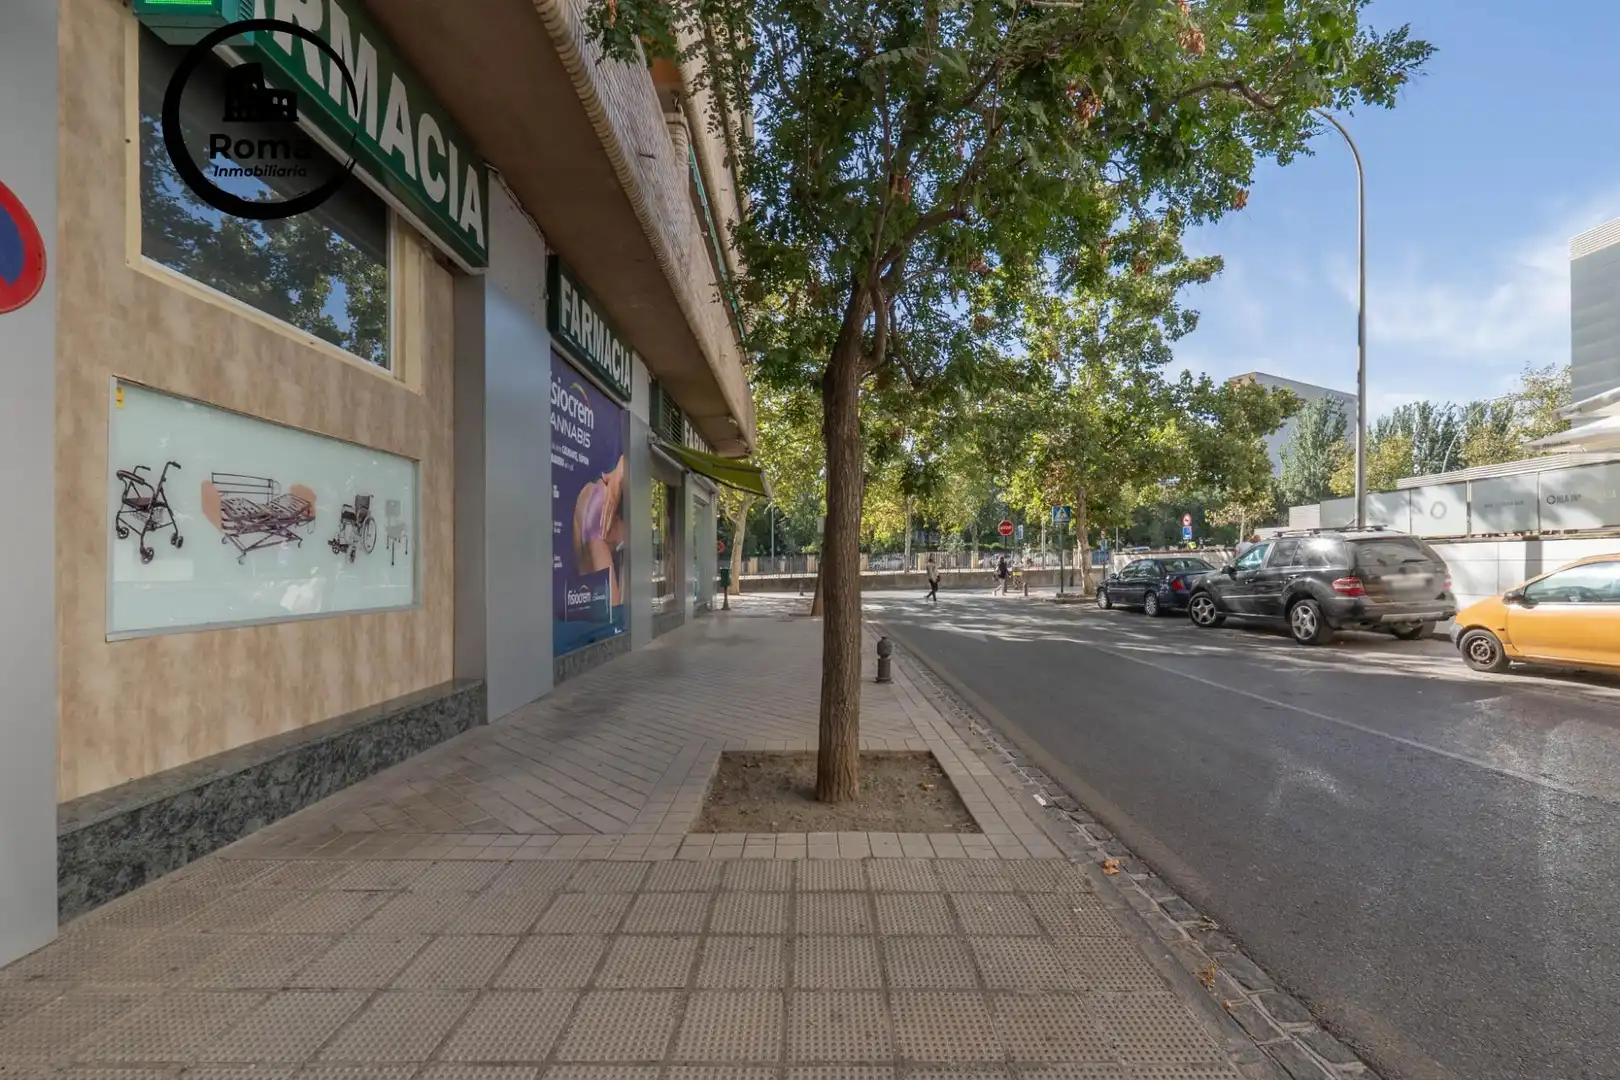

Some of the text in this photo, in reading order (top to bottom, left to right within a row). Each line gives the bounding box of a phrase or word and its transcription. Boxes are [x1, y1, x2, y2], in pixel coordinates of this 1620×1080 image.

[254, 0, 486, 250] RMACIA
[560, 274, 632, 394] FARMACIA
[550, 376, 595, 431] siocrem
